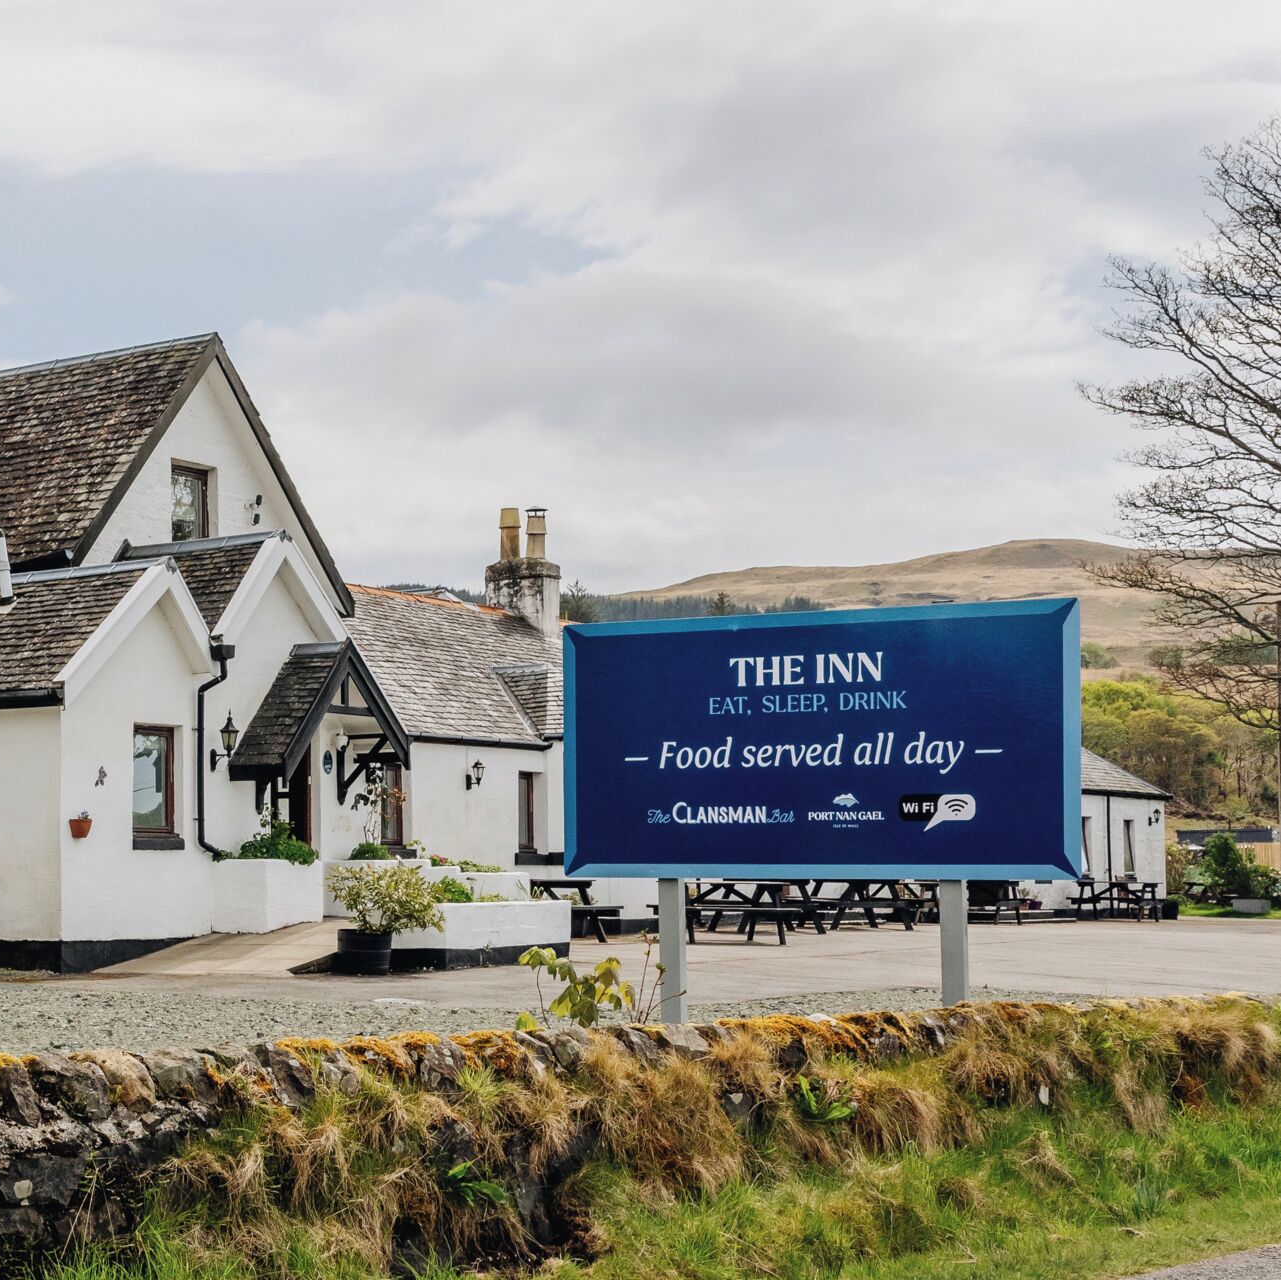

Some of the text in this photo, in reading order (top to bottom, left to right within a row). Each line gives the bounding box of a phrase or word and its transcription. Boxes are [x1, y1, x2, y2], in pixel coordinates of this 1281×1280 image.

[729, 650, 884, 688] THE INN
[709, 690, 908, 717] EAT, SLEEP, DRINK
[659, 730, 965, 775] Food served all day
[647, 801, 795, 824] The CLANSMAN Bar
[807, 810, 885, 821] PORT NAN GAEL
[902, 801, 935, 814] Wi Fi
